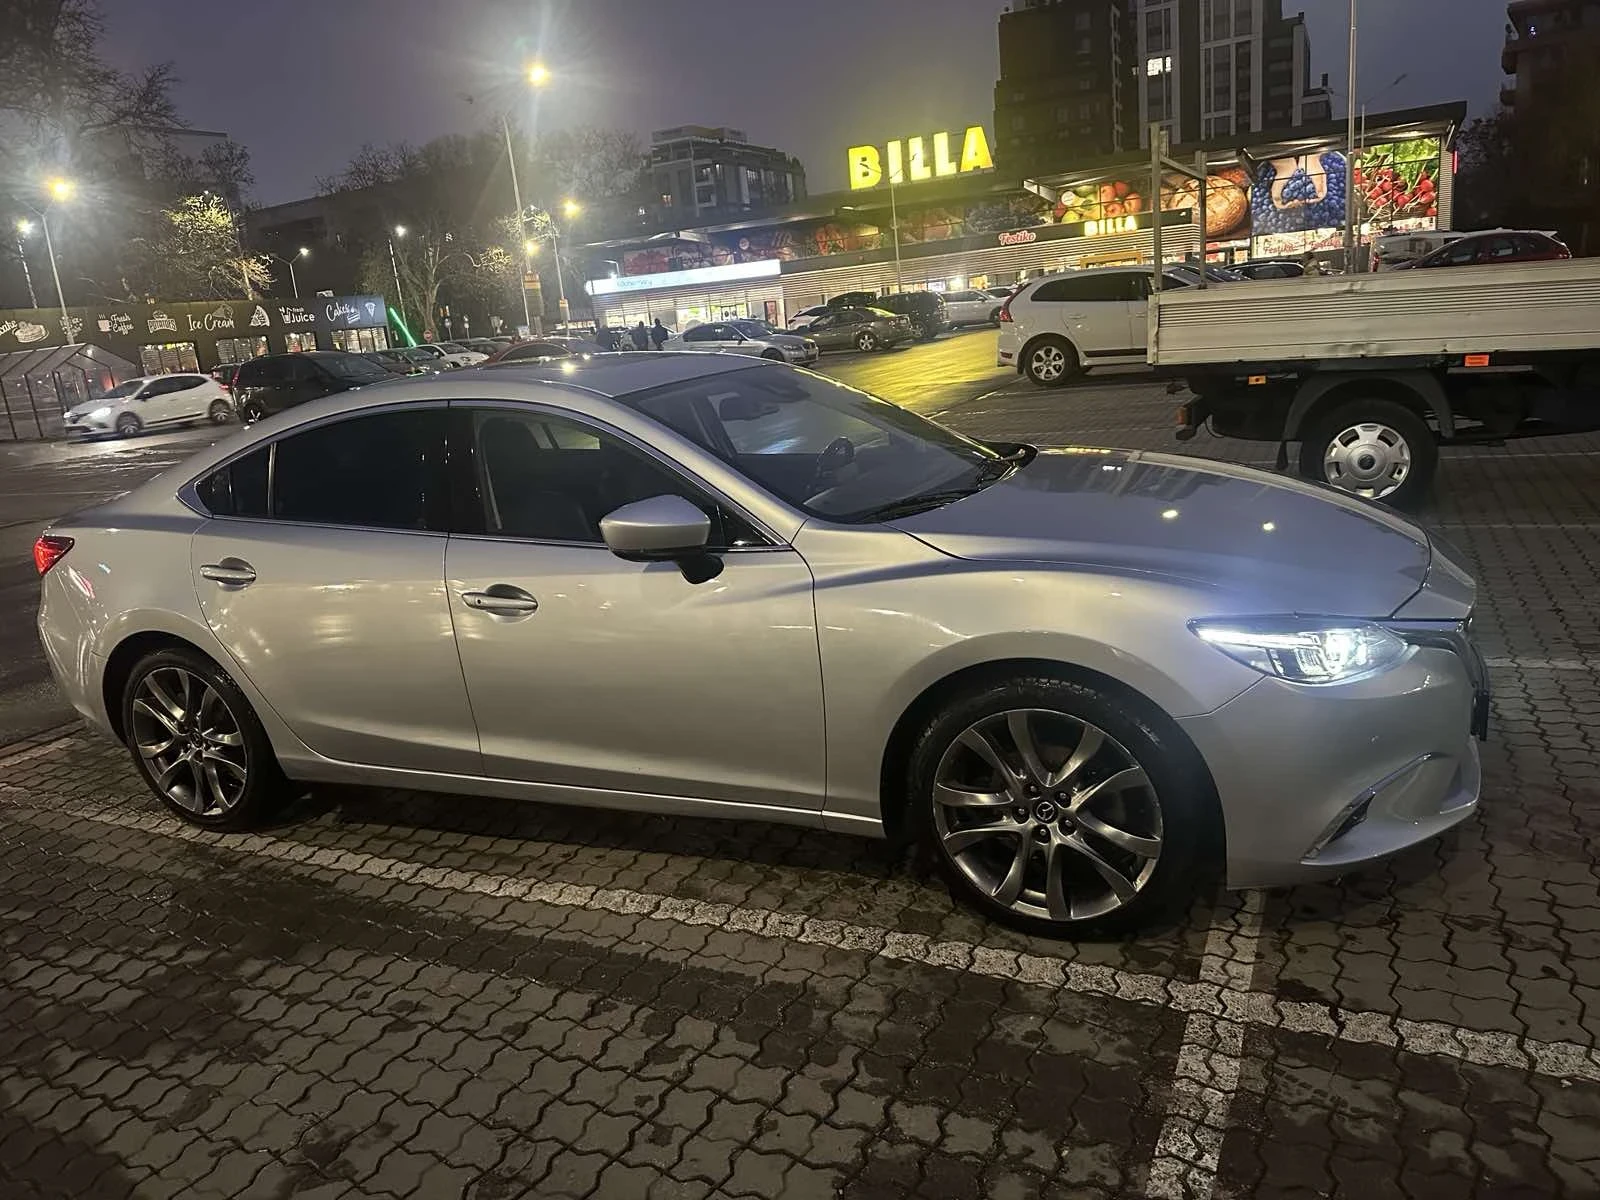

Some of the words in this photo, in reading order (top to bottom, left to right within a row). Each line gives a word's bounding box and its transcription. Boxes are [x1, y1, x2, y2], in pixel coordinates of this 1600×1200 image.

[848, 126, 994, 190] BILLA
[1084, 215, 1138, 237] BILLA
[999, 230, 1037, 245] Festiko
[187, 314, 203, 332] Ice
[204, 314, 235, 331] Cream
[291, 312, 315, 323] Juice
